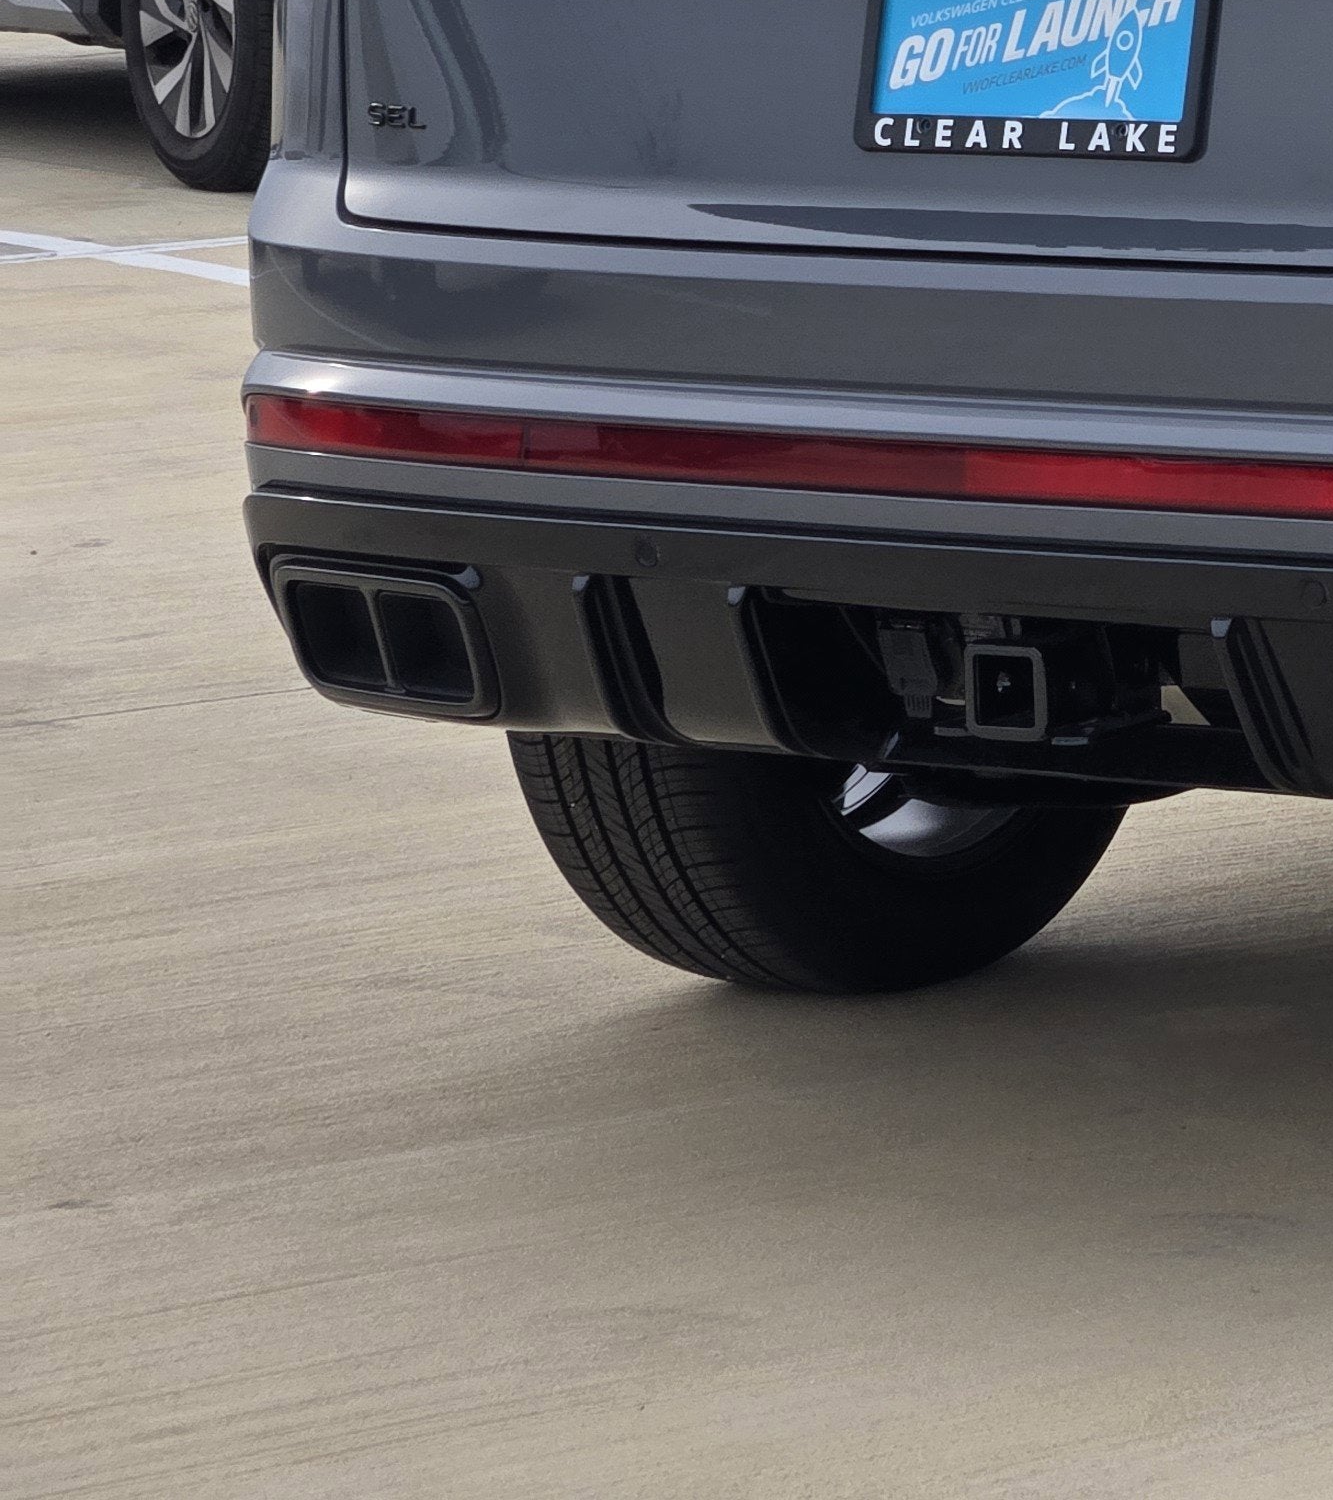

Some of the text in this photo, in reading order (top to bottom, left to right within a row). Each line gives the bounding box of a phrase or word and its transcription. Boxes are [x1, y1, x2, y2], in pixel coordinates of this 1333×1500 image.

[888, 34, 954, 90] GO
[951, 22, 1003, 72] FOR
[961, 54, 1088, 95] VWOFCLEARLAKE.COM
[367, 101, 428, 130] SEL
[874, 117, 1178, 153] CLEAR LAKE
